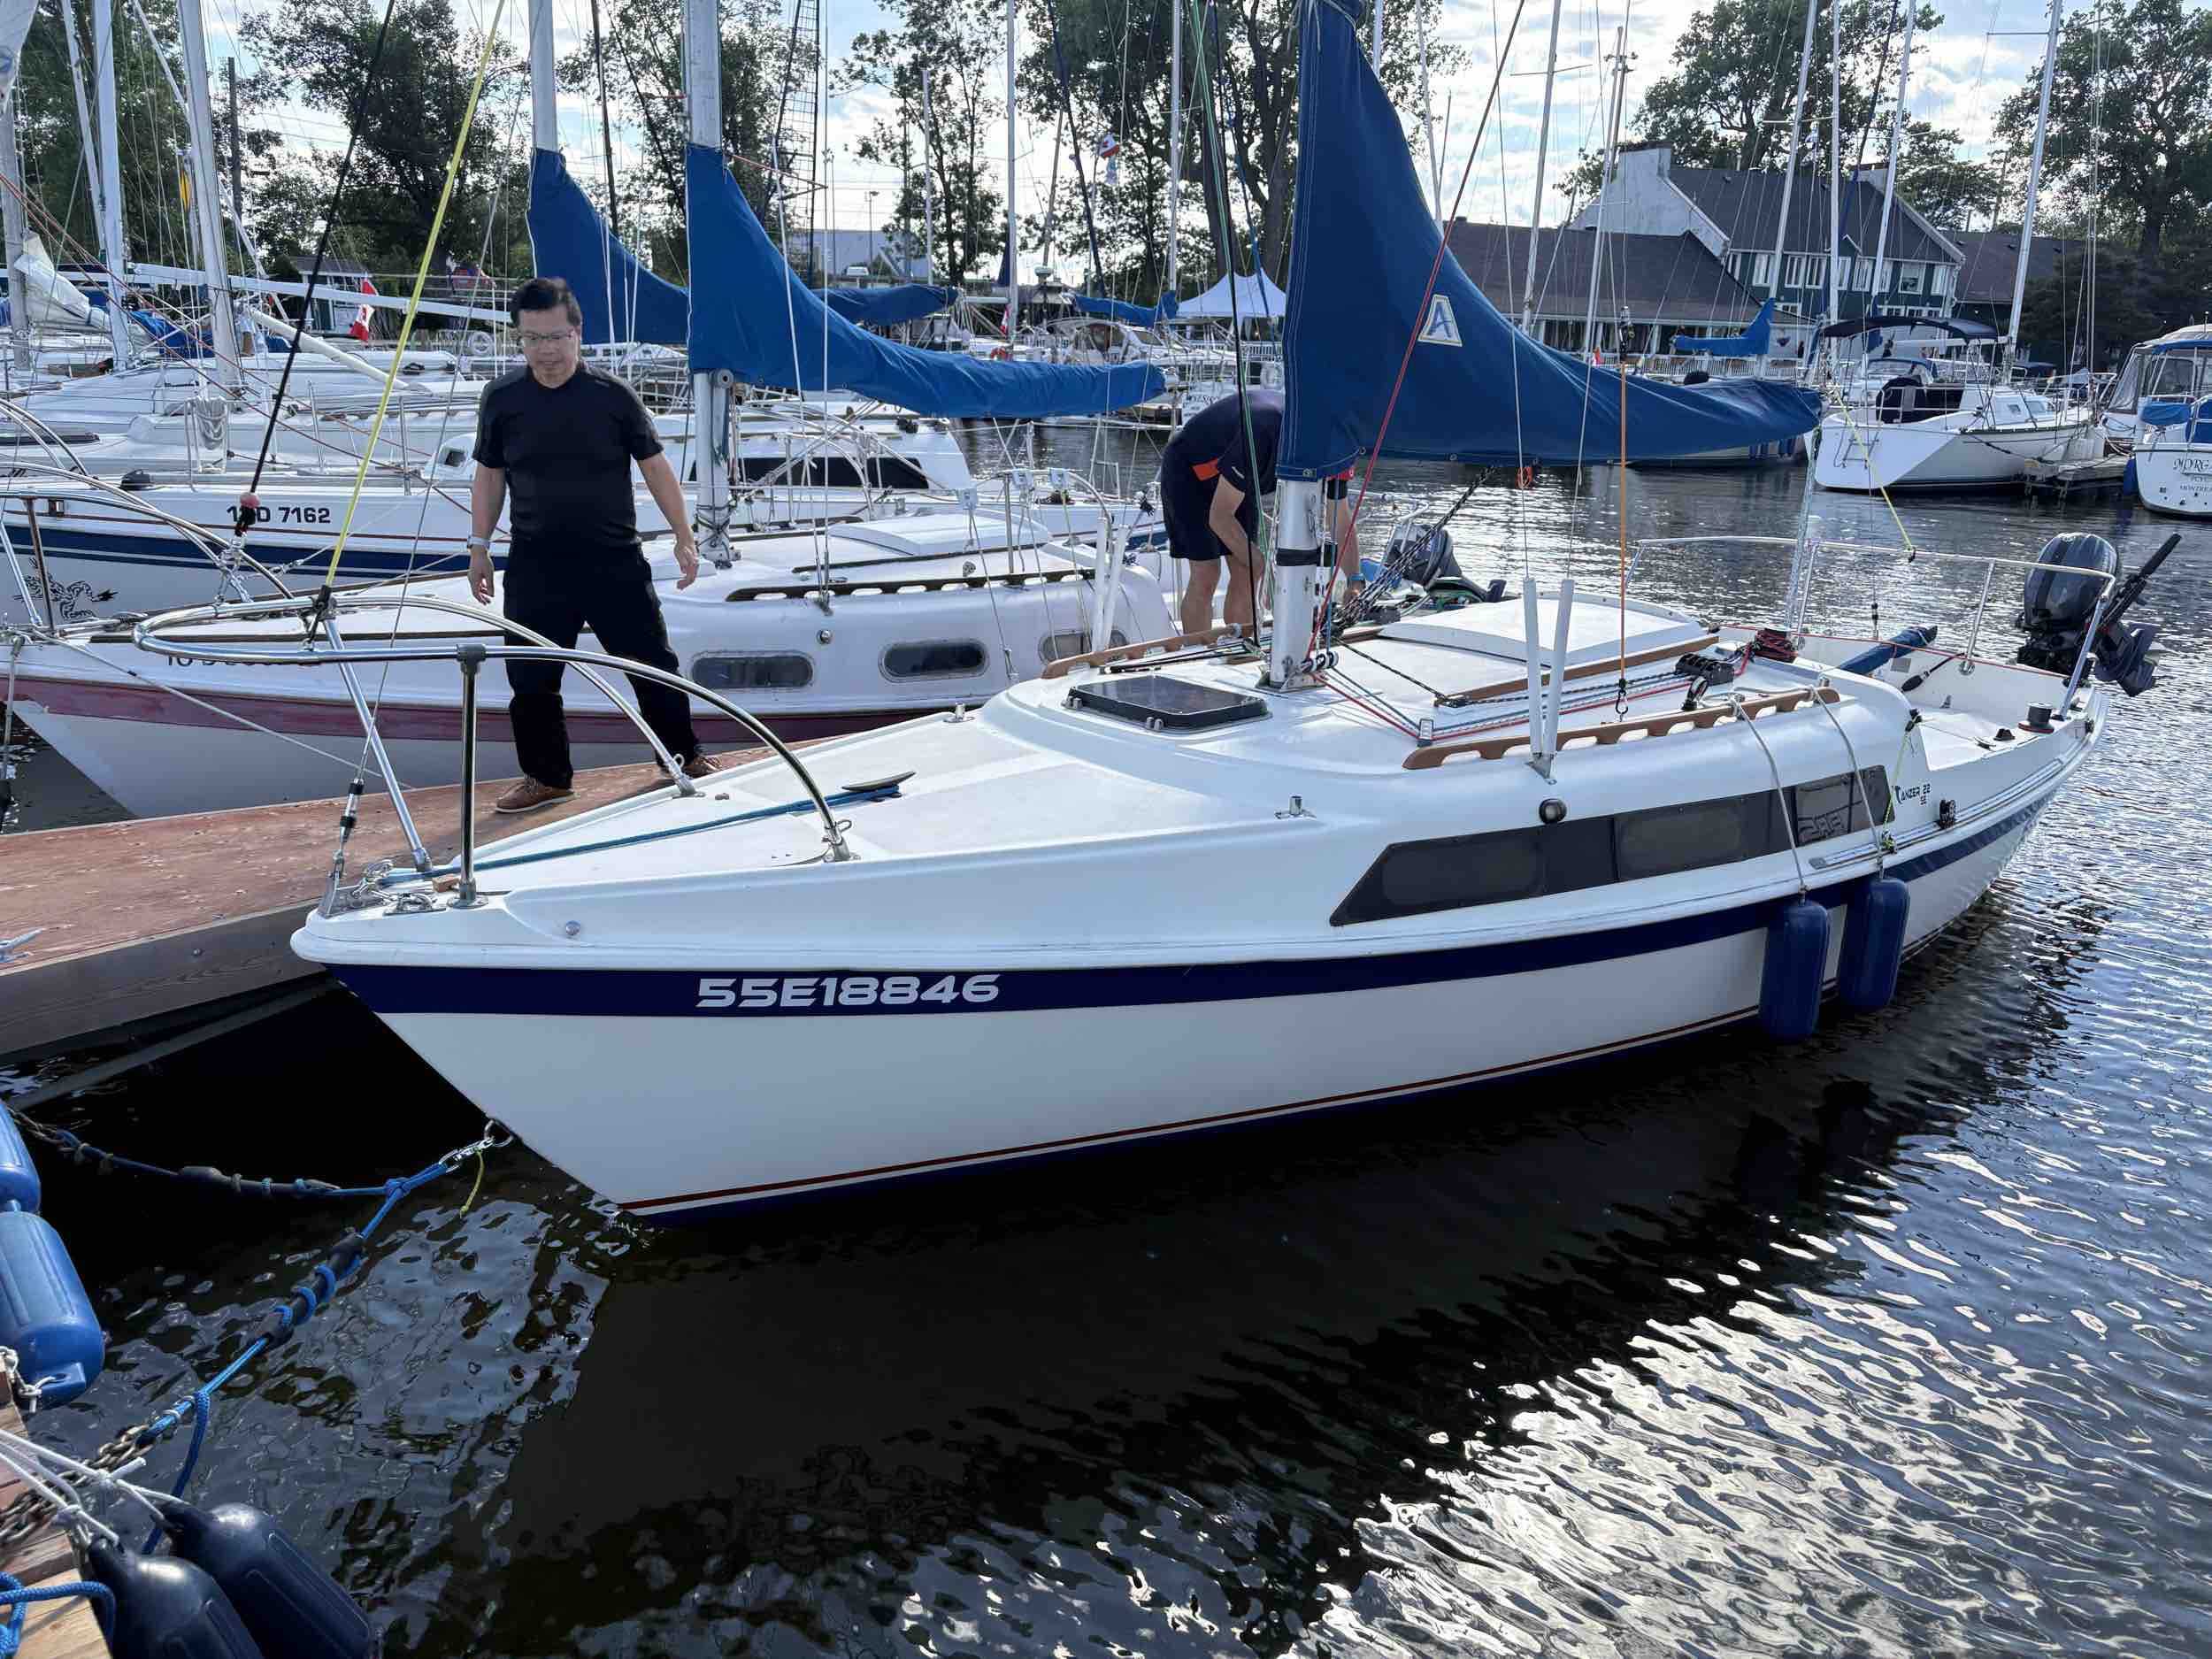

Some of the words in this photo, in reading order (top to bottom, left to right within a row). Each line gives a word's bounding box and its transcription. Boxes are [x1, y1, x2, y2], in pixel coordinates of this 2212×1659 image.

[2173, 458, 2212, 472] MORG
[227, 506, 271, 523] 1D
[278, 506, 331, 524] 7162
[1923, 784, 1931, 795] 22
[695, 973, 1002, 1008] 55E18846
